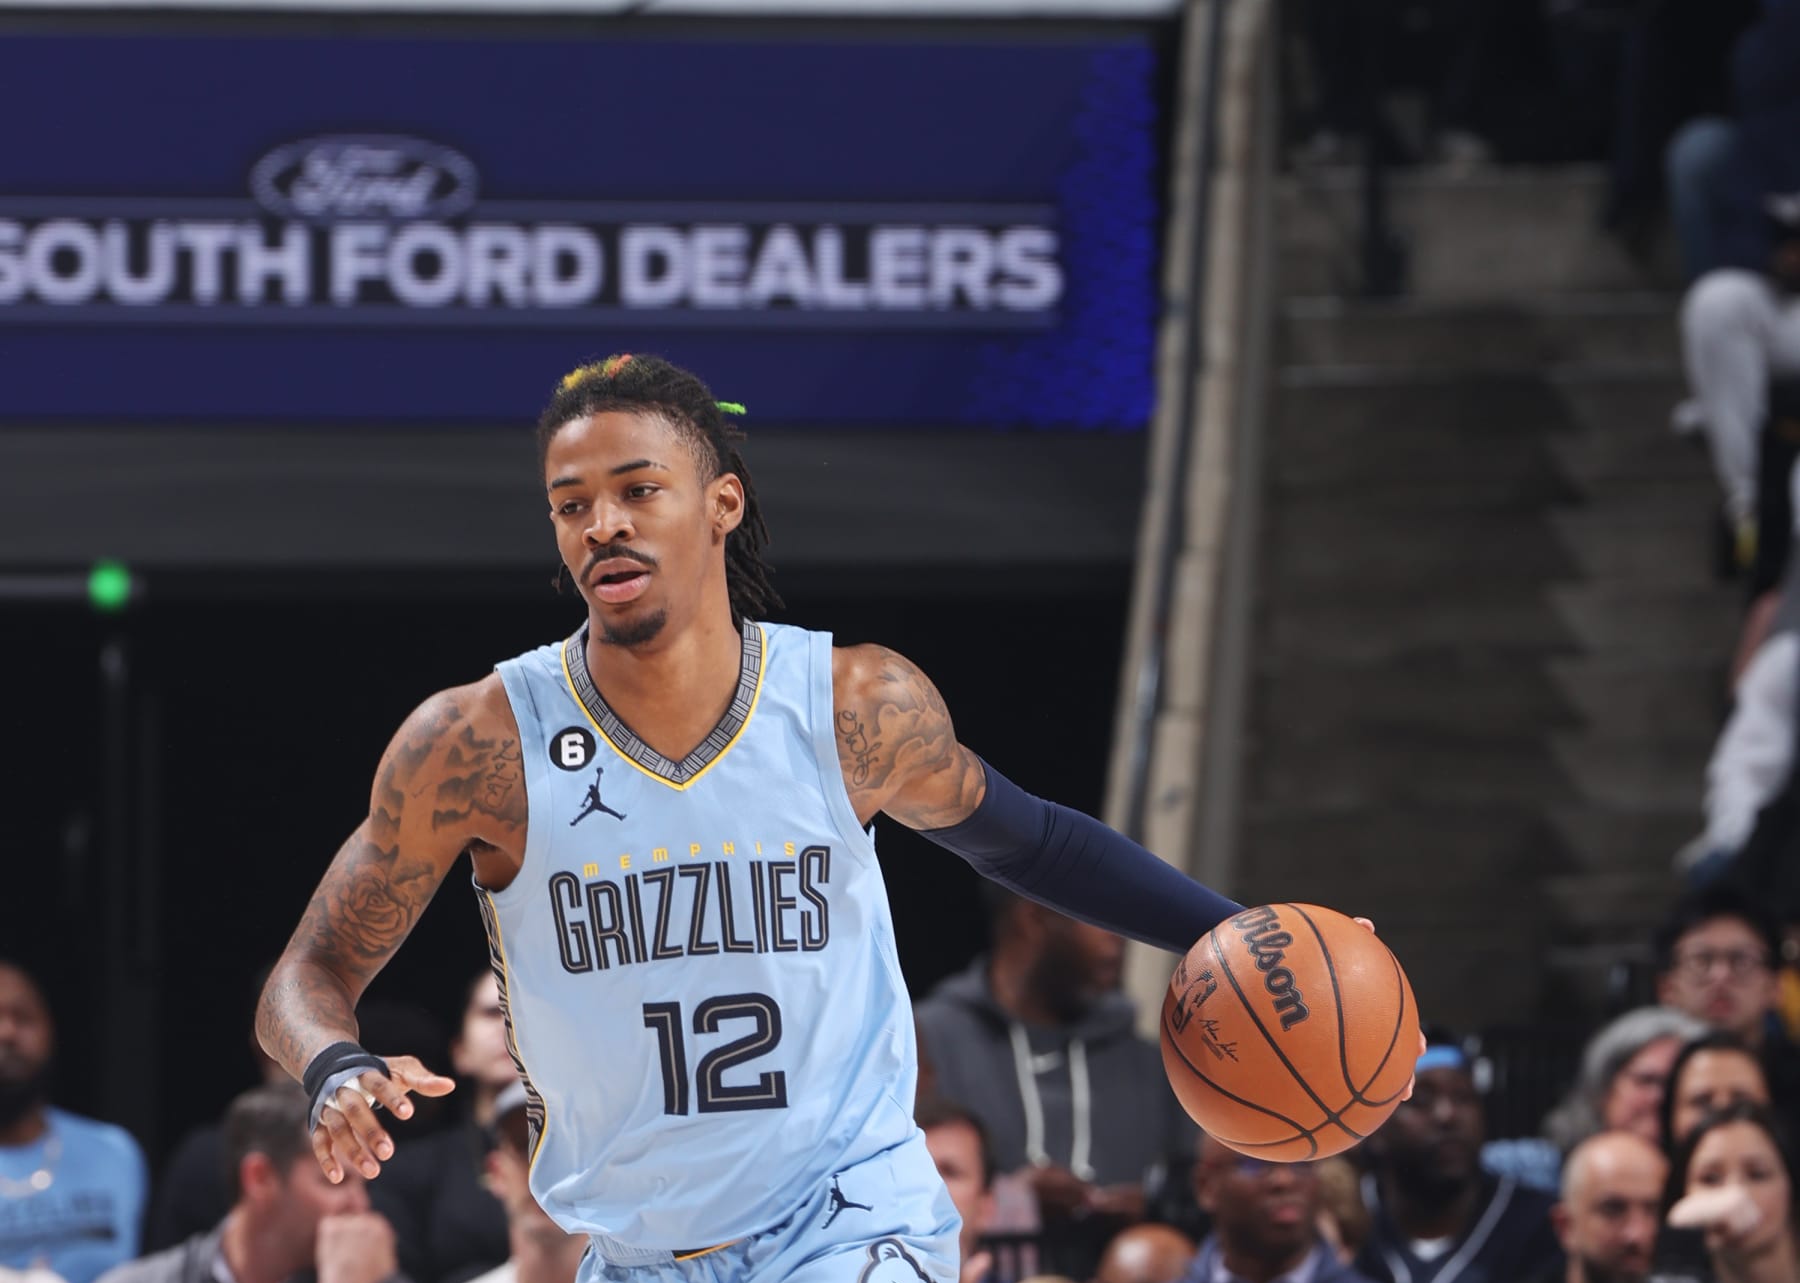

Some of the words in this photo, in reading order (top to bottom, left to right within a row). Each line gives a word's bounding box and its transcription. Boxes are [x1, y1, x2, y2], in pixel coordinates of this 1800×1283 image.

[290, 146, 438, 217] Ford
[332, 223, 602, 306] FORD
[621, 225, 1064, 310] DEALERS
[560, 732, 586, 767] 6
[583, 842, 796, 878] MEMPHIS
[548, 846, 832, 975] GRIZZLIES
[1231, 905, 1310, 1032] Wilson
[643, 992, 788, 1116] 12
